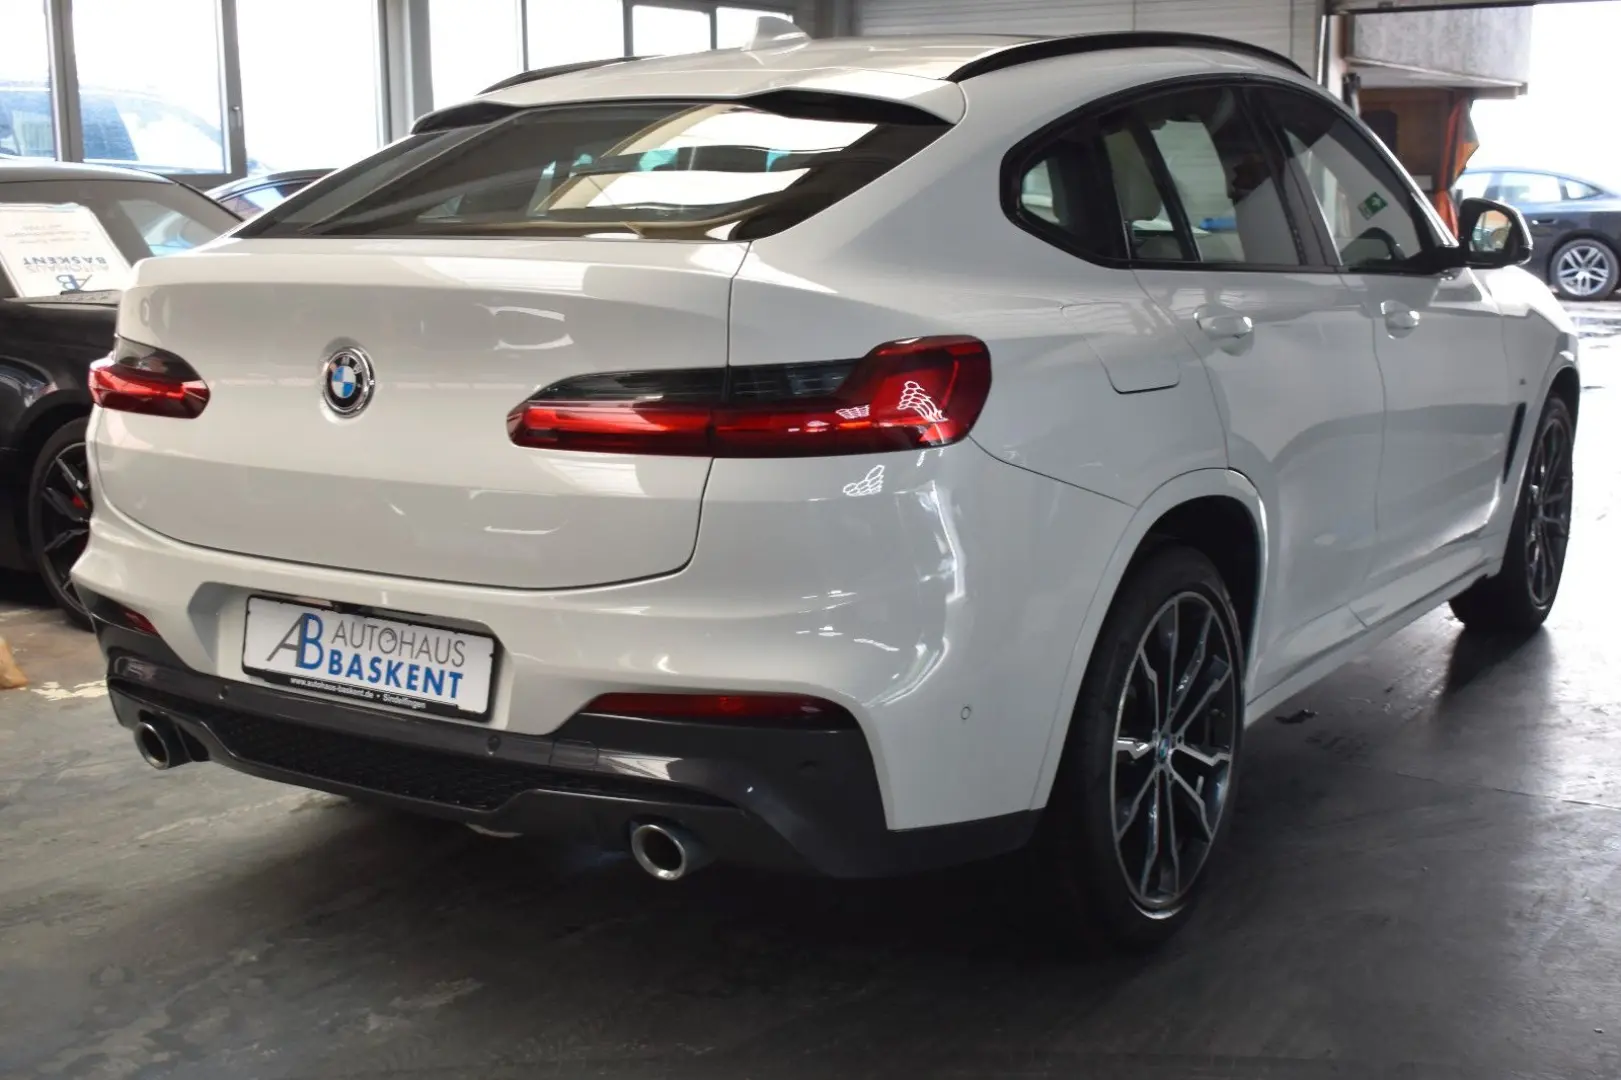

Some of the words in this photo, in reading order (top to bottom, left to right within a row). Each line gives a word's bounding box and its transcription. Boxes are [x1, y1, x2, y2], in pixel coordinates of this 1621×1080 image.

[23, 256, 107, 265] BASKENT
[266, 612, 324, 670] AB
[331, 620, 466, 668] AUTOHAUS
[290, 678, 374, 698] www.autohaus-baskent.de
[383, 693, 426, 709] Sindelfingen
[328, 649, 463, 699] BASKENT
